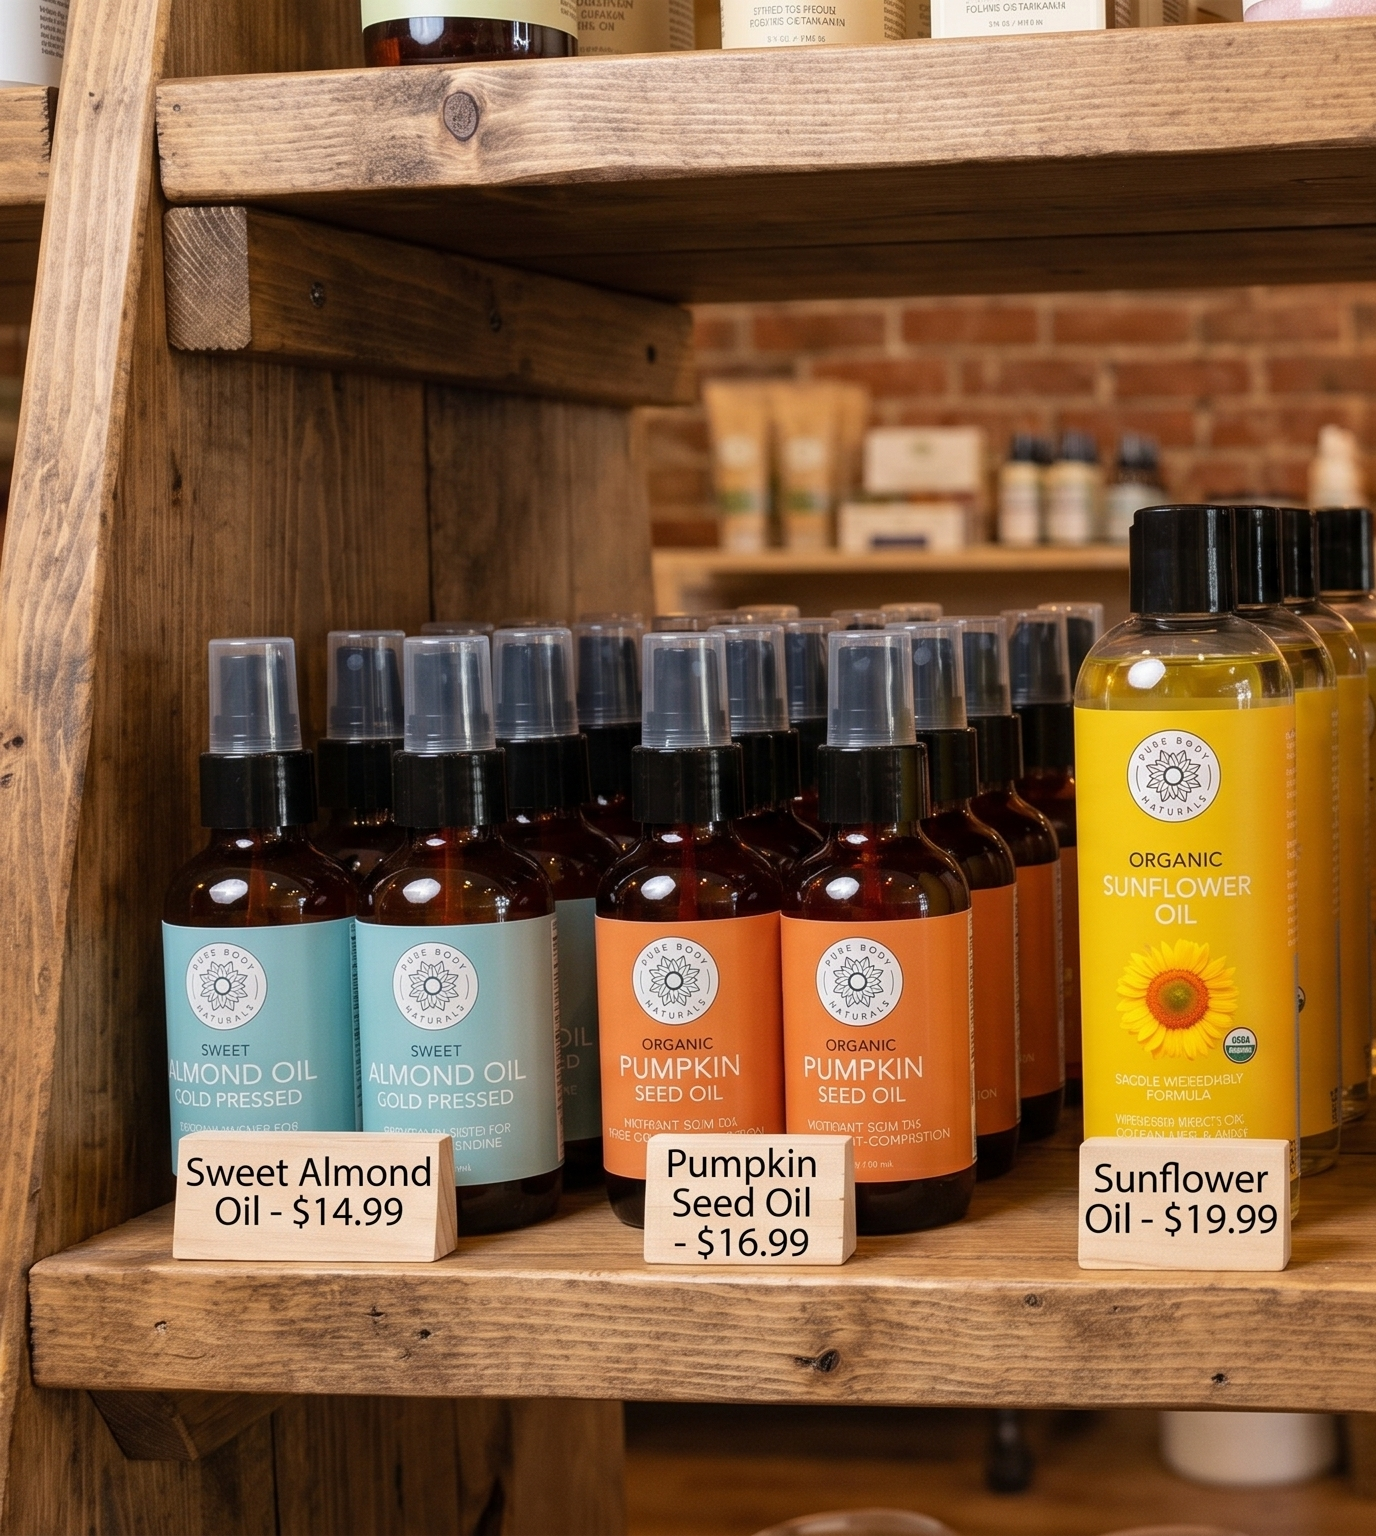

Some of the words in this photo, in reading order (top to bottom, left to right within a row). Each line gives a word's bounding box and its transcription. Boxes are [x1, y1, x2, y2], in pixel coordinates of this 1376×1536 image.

[1129, 851, 1223, 868] ORGANIC
[1103, 874, 1252, 898] SUNFLOWER
[1154, 903, 1197, 925] OIL
[223, 948, 255, 970] BODY
[434, 948, 467, 970] BODY
[200, 1043, 251, 1057] SWEET
[411, 1044, 462, 1058] SWEET
[641, 1037, 714, 1051] ORGANIC
[826, 1038, 897, 1052] ORGANIC
[168, 1058, 263, 1086] ALMOND
[271, 1059, 318, 1084] OIL
[368, 1061, 475, 1087] ALMOND
[483, 1059, 527, 1084] OIL
[619, 1053, 740, 1080] PUMPKIN
[803, 1055, 924, 1081] PUMPKIN
[216, 1089, 303, 1109] PRESSED
[428, 1089, 514, 1110] PRESSED
[634, 1084, 683, 1103] SEED
[688, 1084, 724, 1102] OIL
[818, 1085, 866, 1104] SEED
[872, 1086, 907, 1104] OIL
[1146, 1089, 1212, 1101] FORMULA
[489, 1122, 511, 1135] FOR
[186, 1157, 289, 1187] Sweet
[298, 1156, 431, 1187] Almond
[668, 1147, 816, 1186] Pumpkin
[1094, 1161, 1269, 1193] Sunflower
[215, 1194, 259, 1226] Oil
[293, 1194, 403, 1229] $14.99
[673, 1186, 754, 1218] Seed
[766, 1186, 810, 1218] Oil
[1085, 1202, 1130, 1234] Oil
[1165, 1201, 1278, 1237] $19.99
[697, 1225, 809, 1260] $16.99
